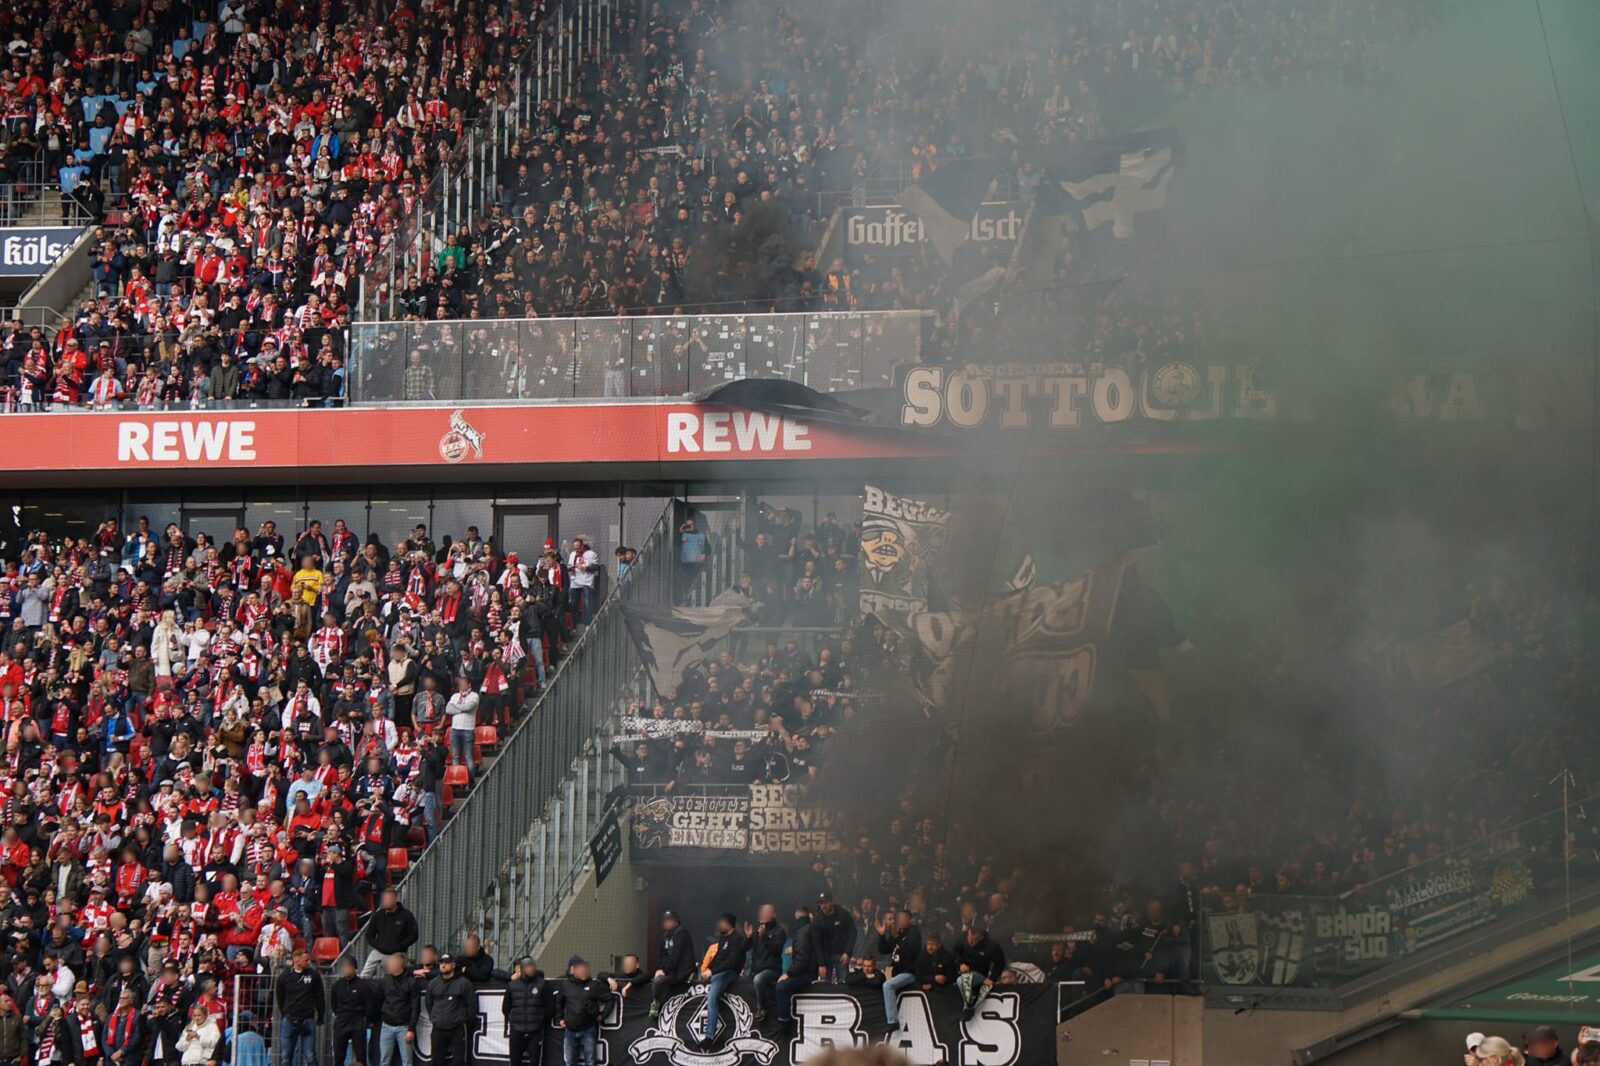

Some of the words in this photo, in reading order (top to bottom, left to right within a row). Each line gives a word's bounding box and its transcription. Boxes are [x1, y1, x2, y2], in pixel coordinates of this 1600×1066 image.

[964, 210, 1022, 241] lsch
[118, 421, 256, 462] REWE
[667, 412, 812, 452] REWE
[673, 812, 744, 831] GEHT
[670, 829, 748, 849] EINIGES
[1316, 912, 1390, 938] BANDA
